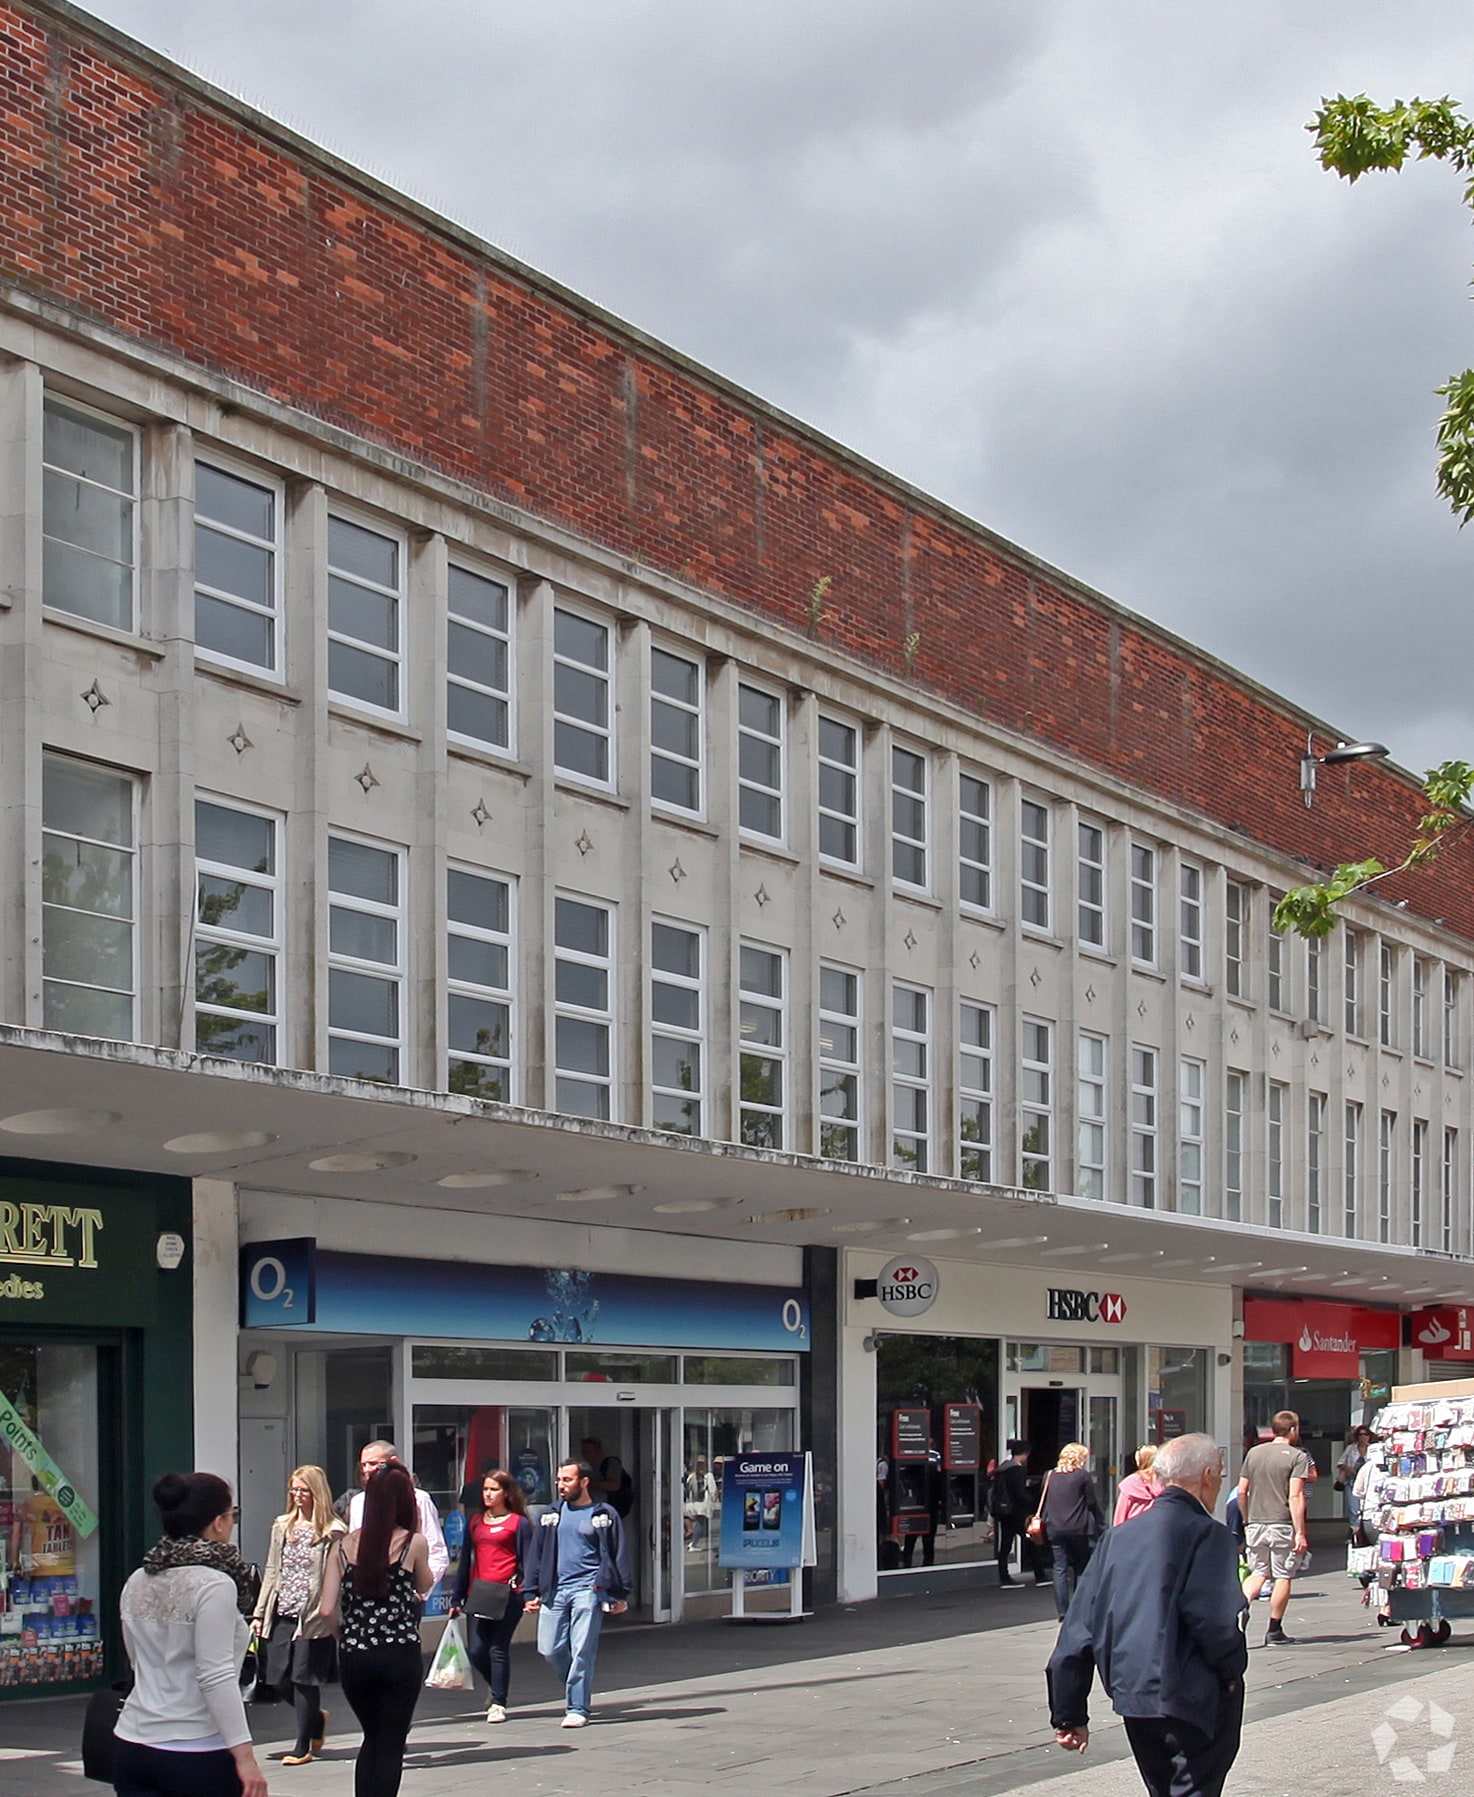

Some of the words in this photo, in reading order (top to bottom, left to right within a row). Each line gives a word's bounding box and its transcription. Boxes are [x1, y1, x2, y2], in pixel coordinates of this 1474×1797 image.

[881, 1283, 932, 1302] HSBC
[1046, 1288, 1100, 1323] HSBC
[1313, 1330, 1357, 1353] Santander
[0, 1409, 37, 1461] Points
[739, 1462, 772, 1473] Game
[773, 1463, 789, 1473] on
[46, 1523, 71, 1541] TAN
